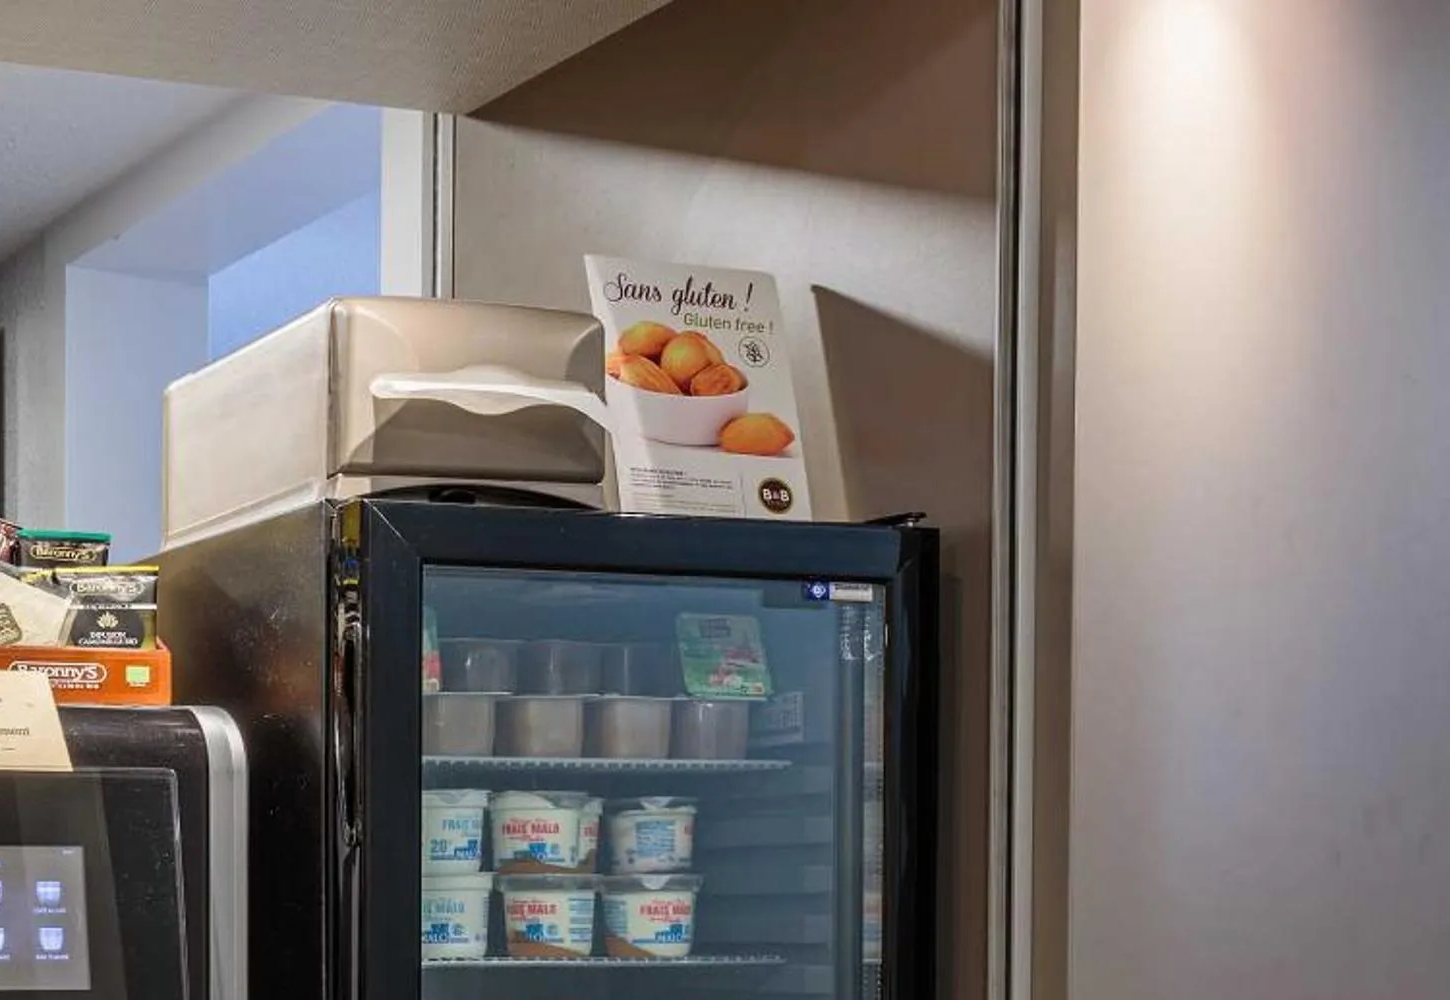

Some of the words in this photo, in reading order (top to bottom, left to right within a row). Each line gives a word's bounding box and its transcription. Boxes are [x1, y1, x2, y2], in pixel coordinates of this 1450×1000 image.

[604, 272, 662, 303] Sans
[671, 275, 738, 315] gluten
[683, 311, 732, 331] Gluten
[734, 317, 766, 334] free
